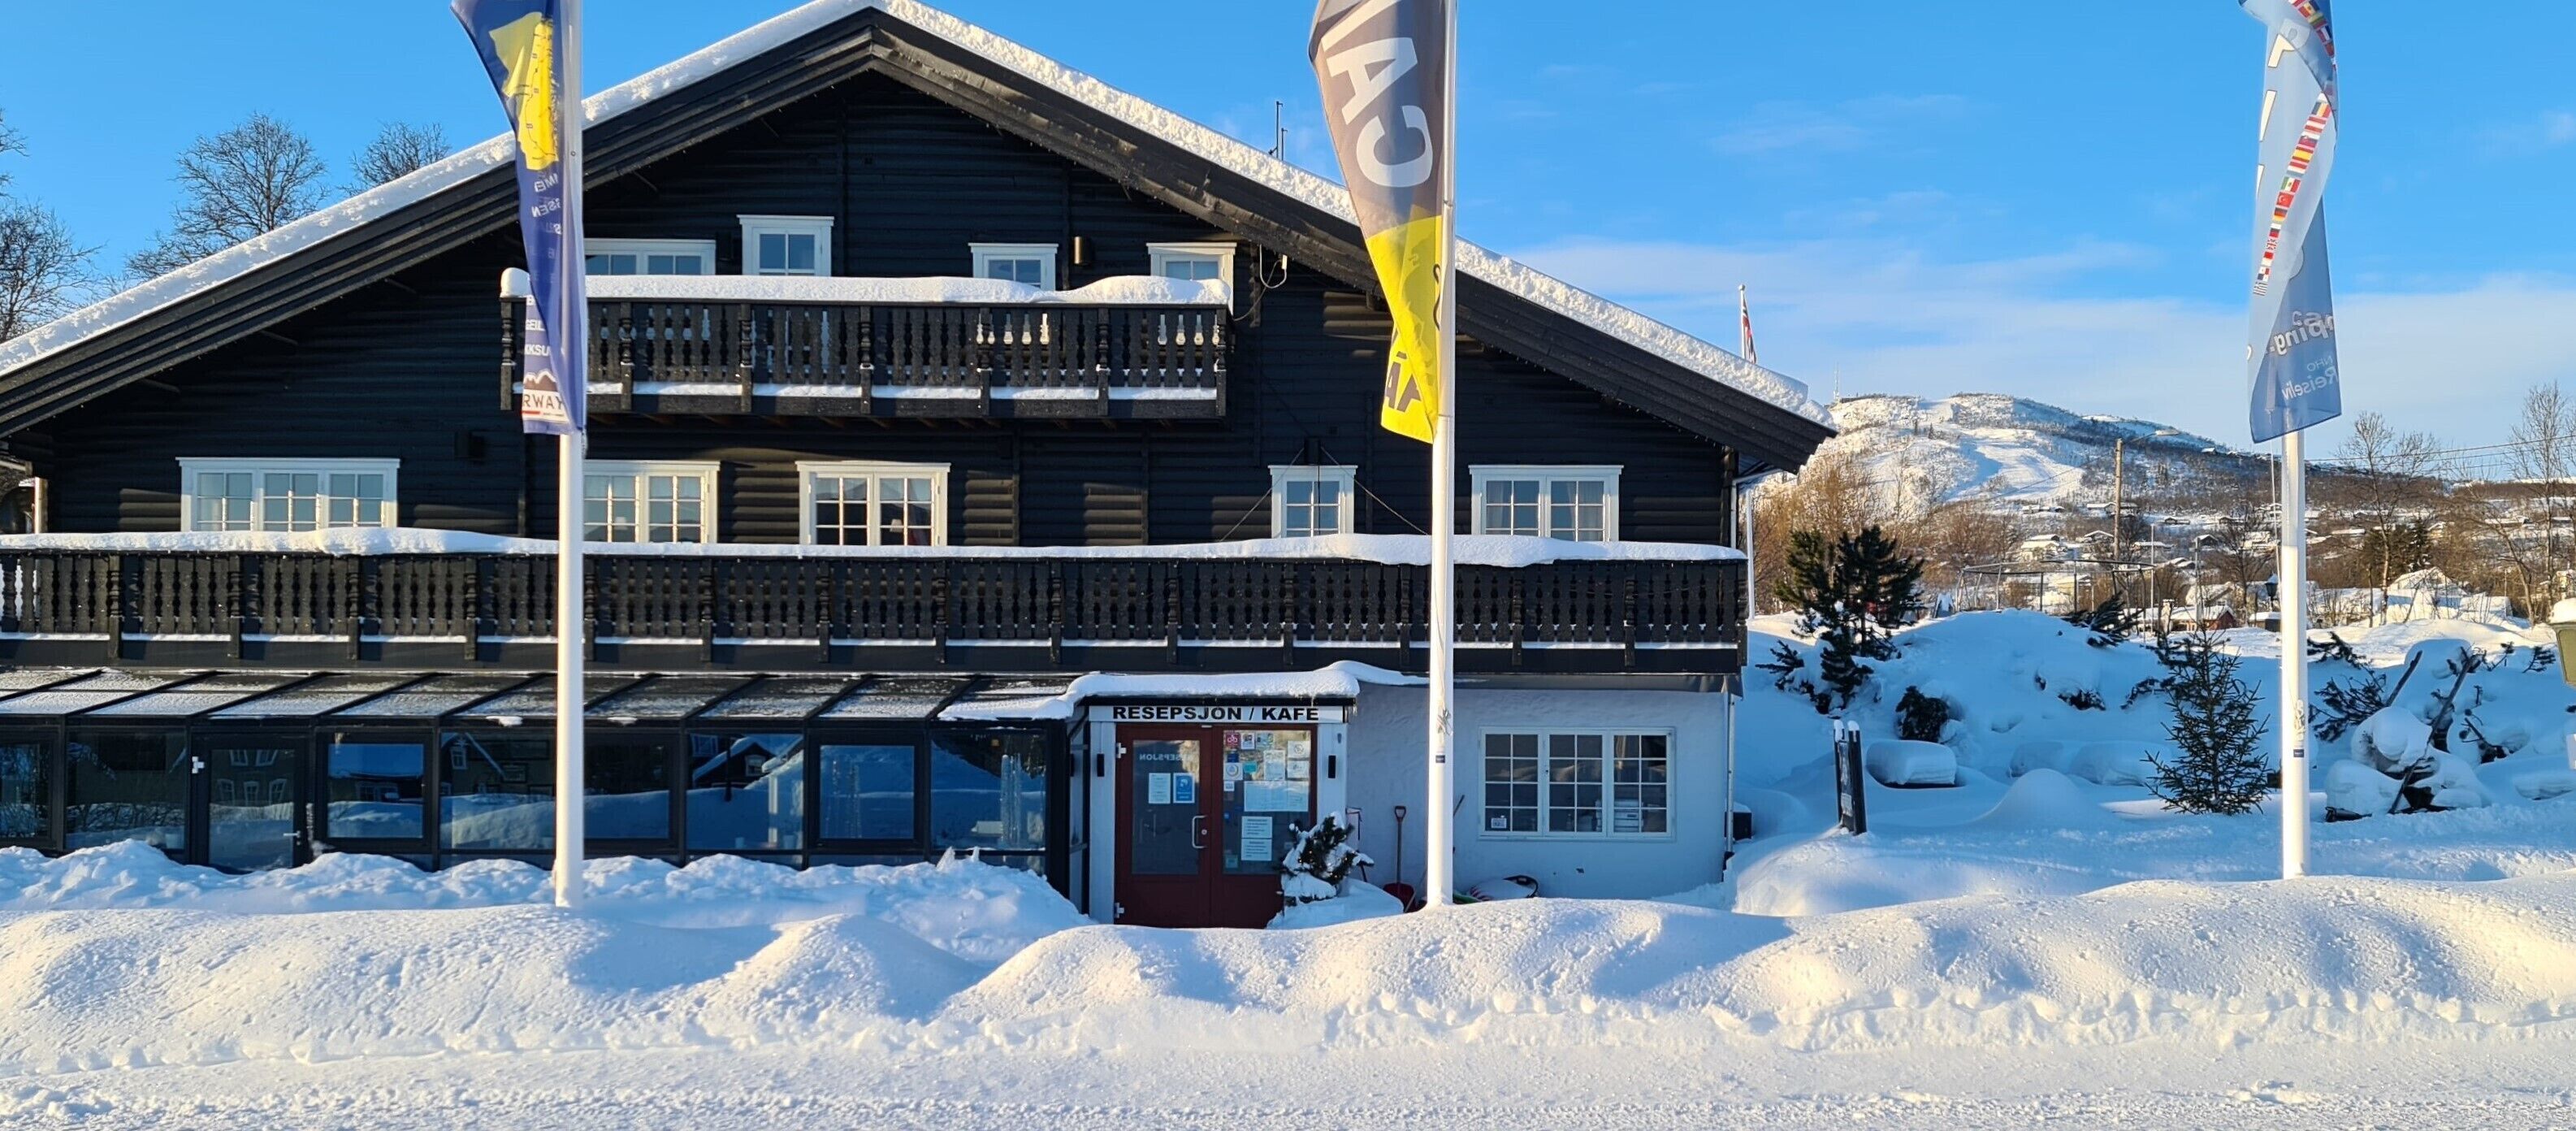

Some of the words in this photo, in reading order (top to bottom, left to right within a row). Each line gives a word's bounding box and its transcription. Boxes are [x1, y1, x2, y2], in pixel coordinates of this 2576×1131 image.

[522, 394, 563, 410] RWAY
[1113, 706, 1242, 720] RESEPSJON
[1262, 707, 1319, 721] KAFE
